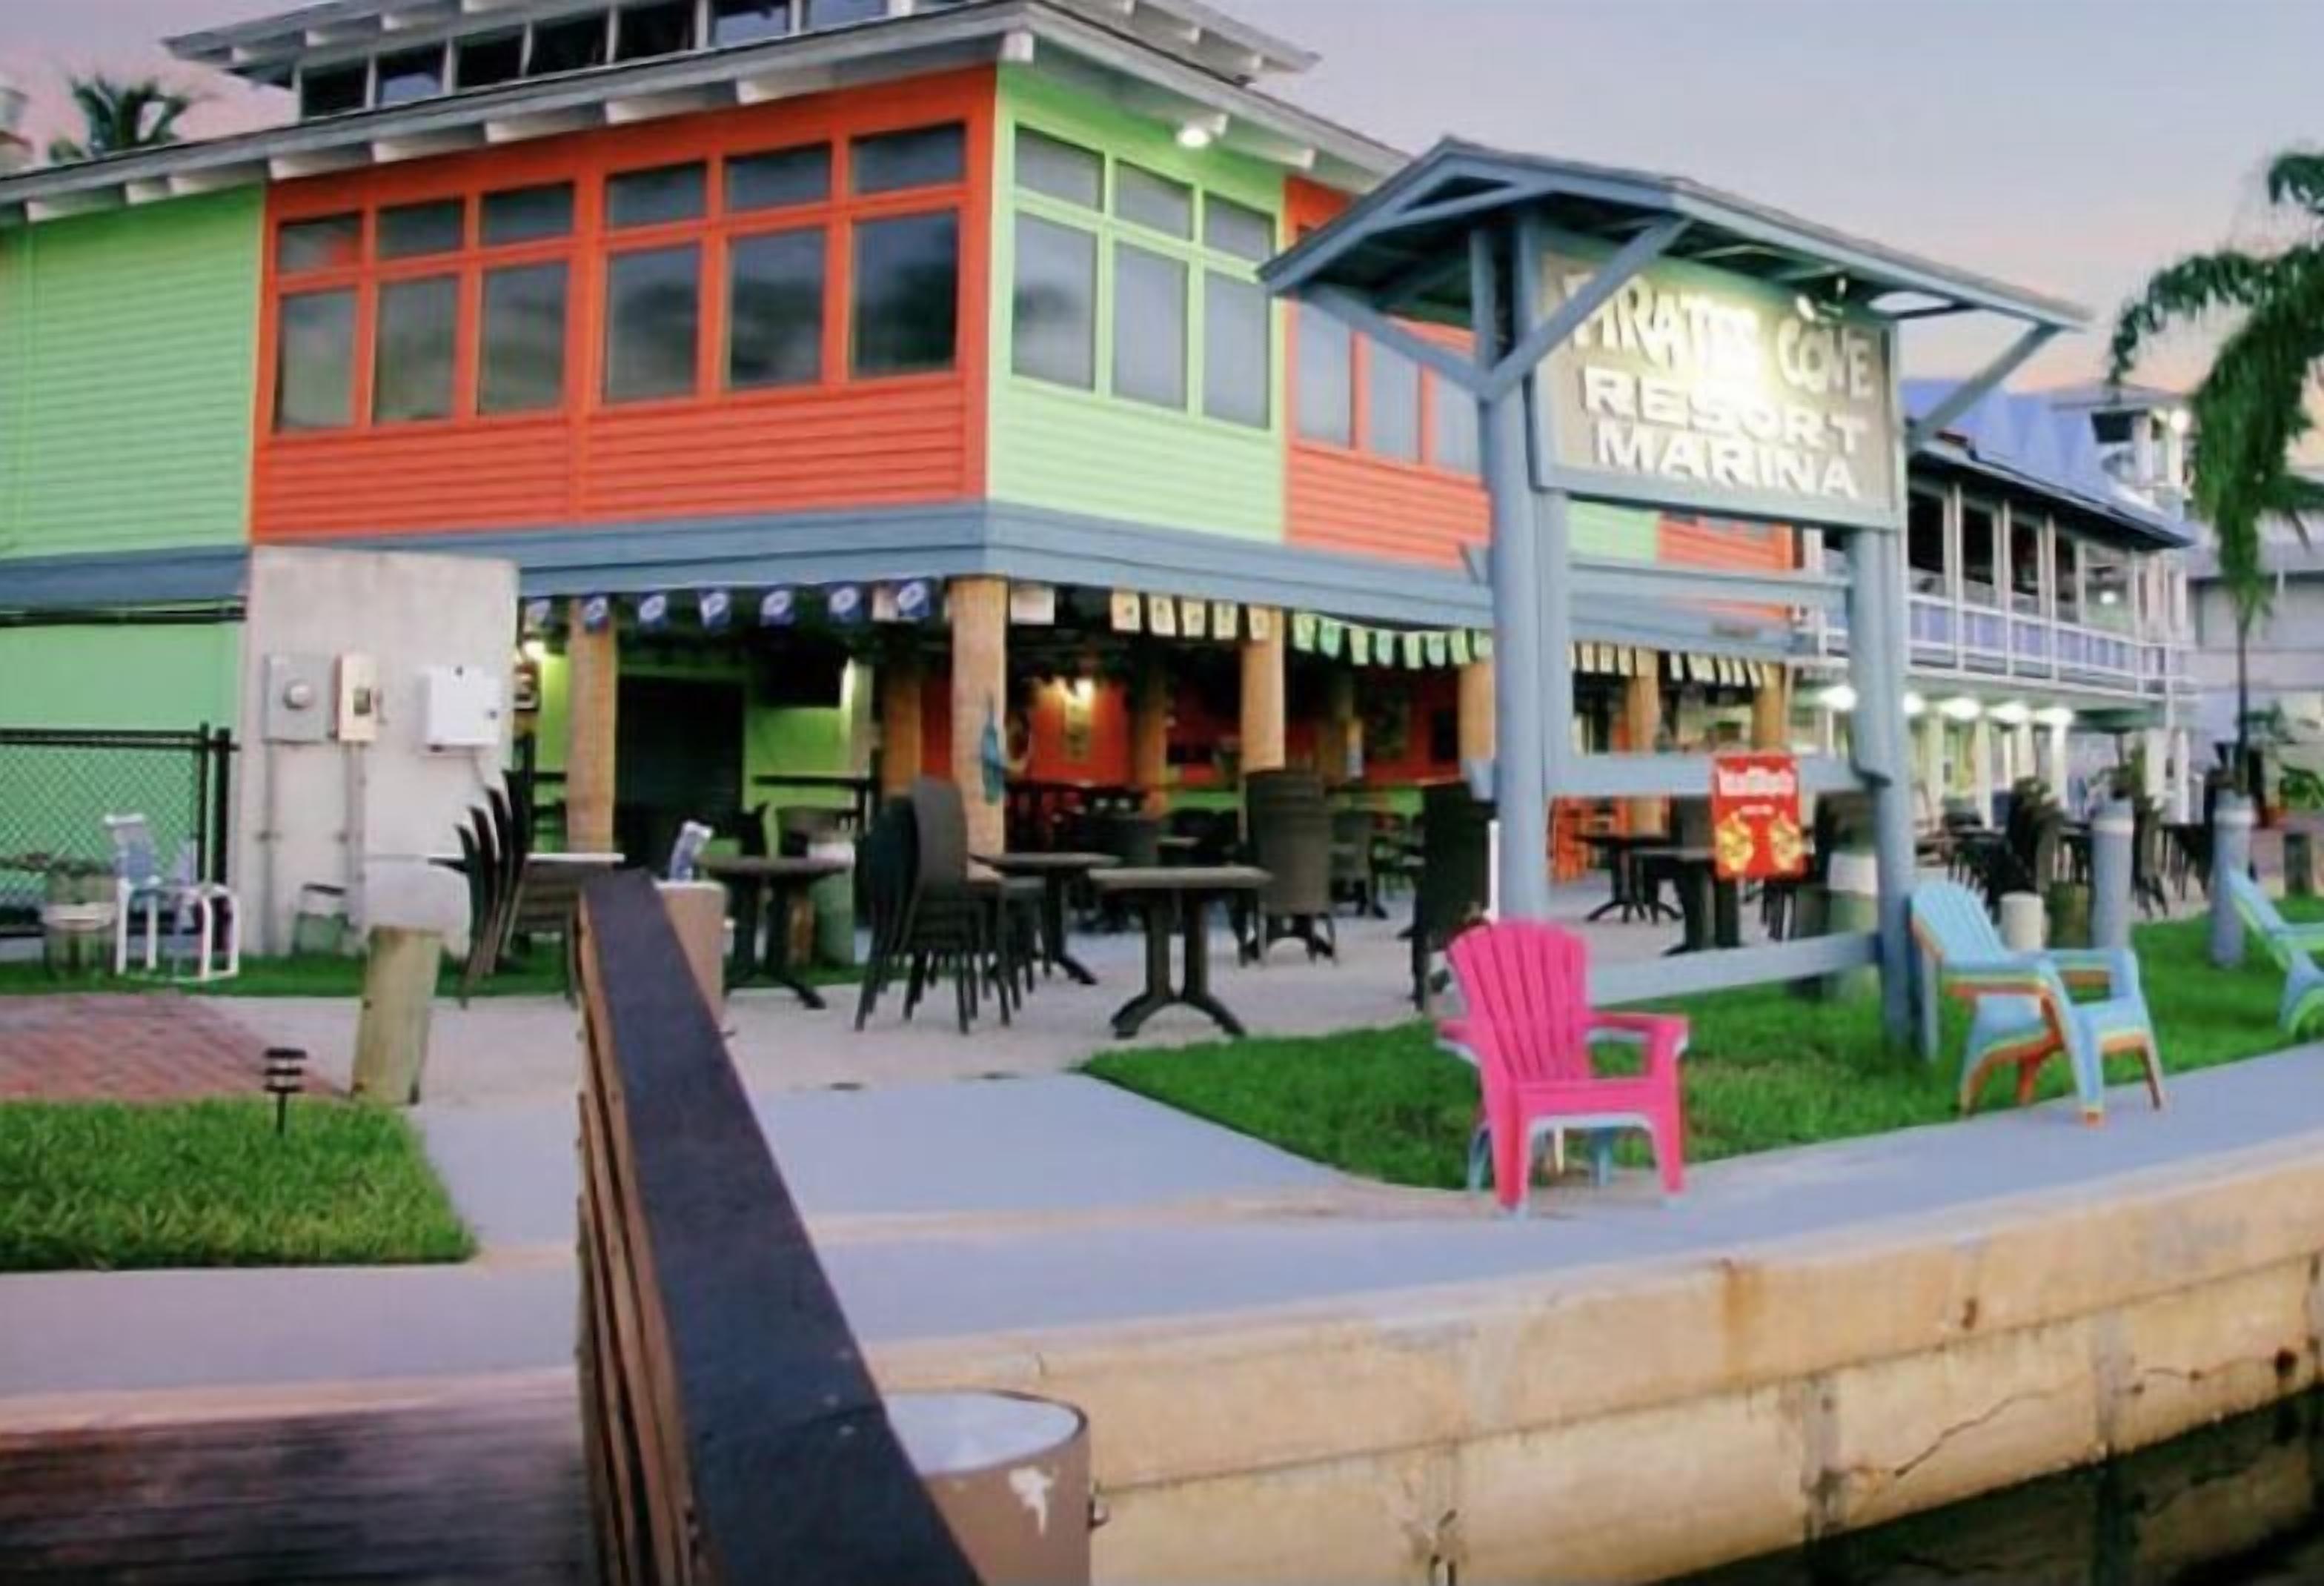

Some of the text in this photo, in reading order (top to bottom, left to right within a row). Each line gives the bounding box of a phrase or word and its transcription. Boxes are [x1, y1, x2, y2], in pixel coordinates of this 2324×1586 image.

[1562, 271, 1874, 398] IRAT COVE
[1584, 366, 1868, 454] RESORT
[1596, 419, 1860, 499] MARINA
